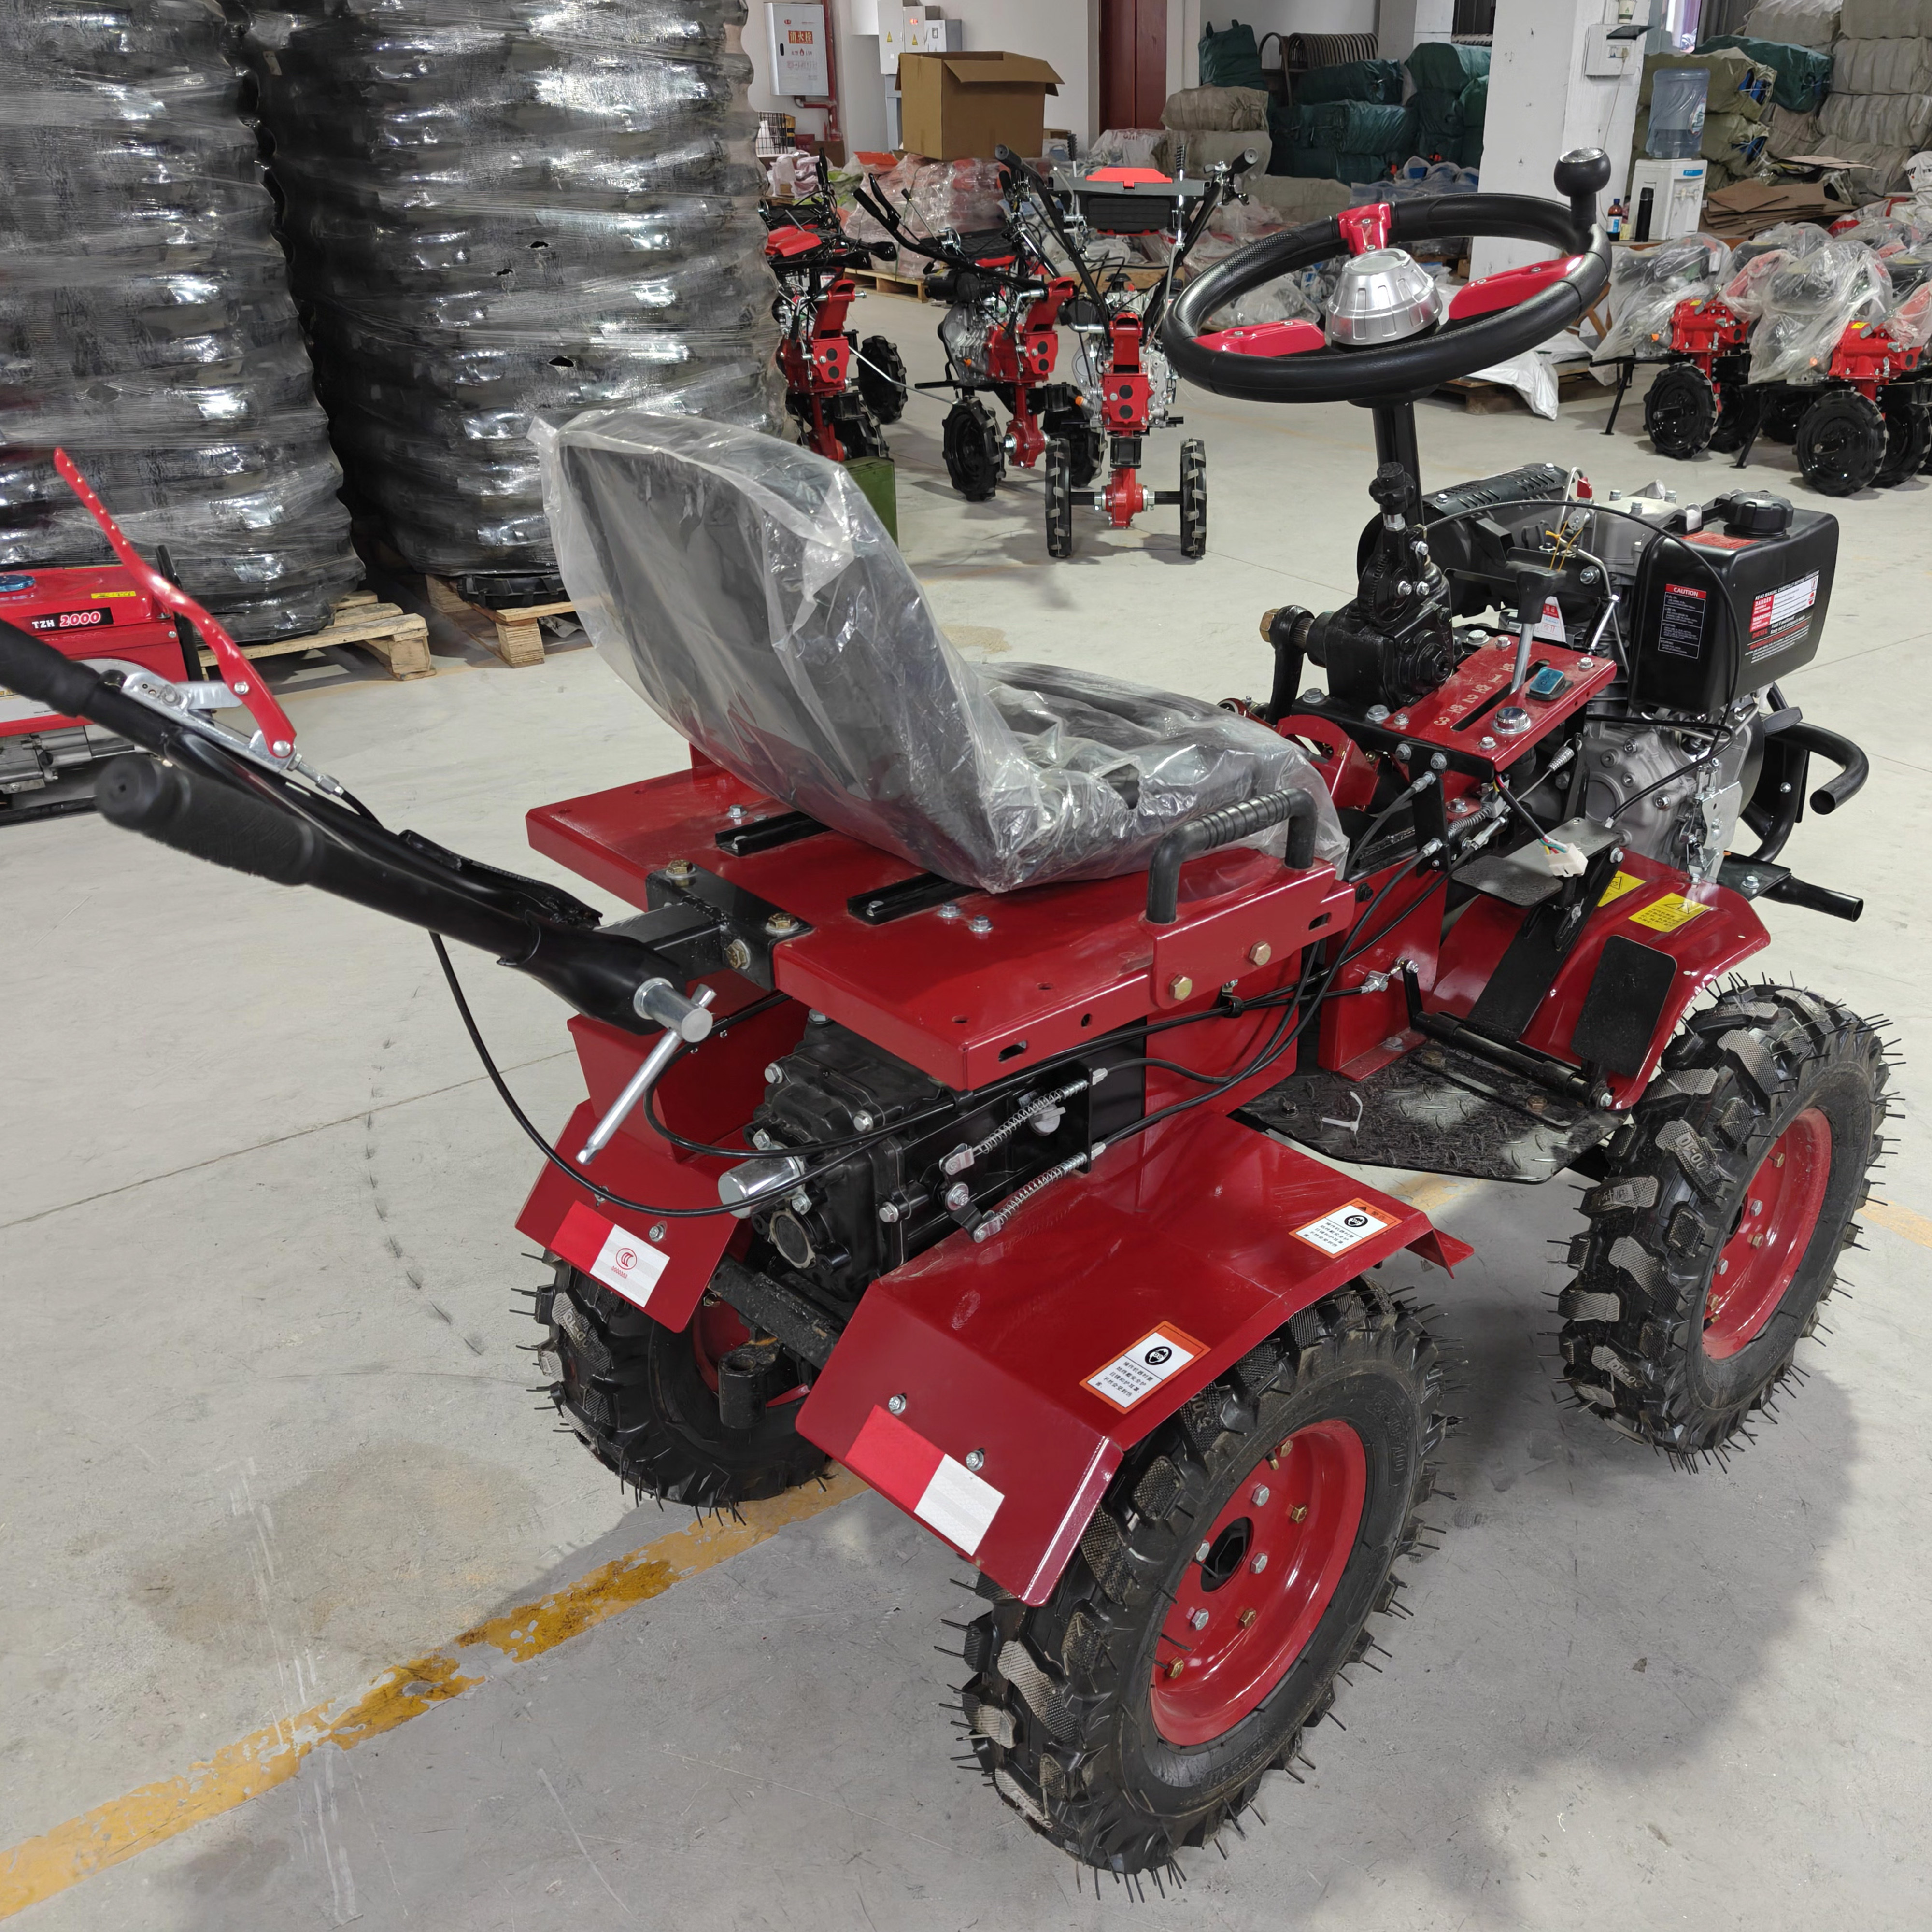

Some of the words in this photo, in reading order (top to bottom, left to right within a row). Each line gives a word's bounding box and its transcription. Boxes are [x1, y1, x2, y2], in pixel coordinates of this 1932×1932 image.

[1673, 587, 1699, 597] CAUTION
[32, 619, 55, 629] TZH
[59, 611, 101, 627] 2000
[1488, 674, 1502, 683] 1
[1462, 694, 1478, 703] 2
[1434, 716, 1450, 725] 3
